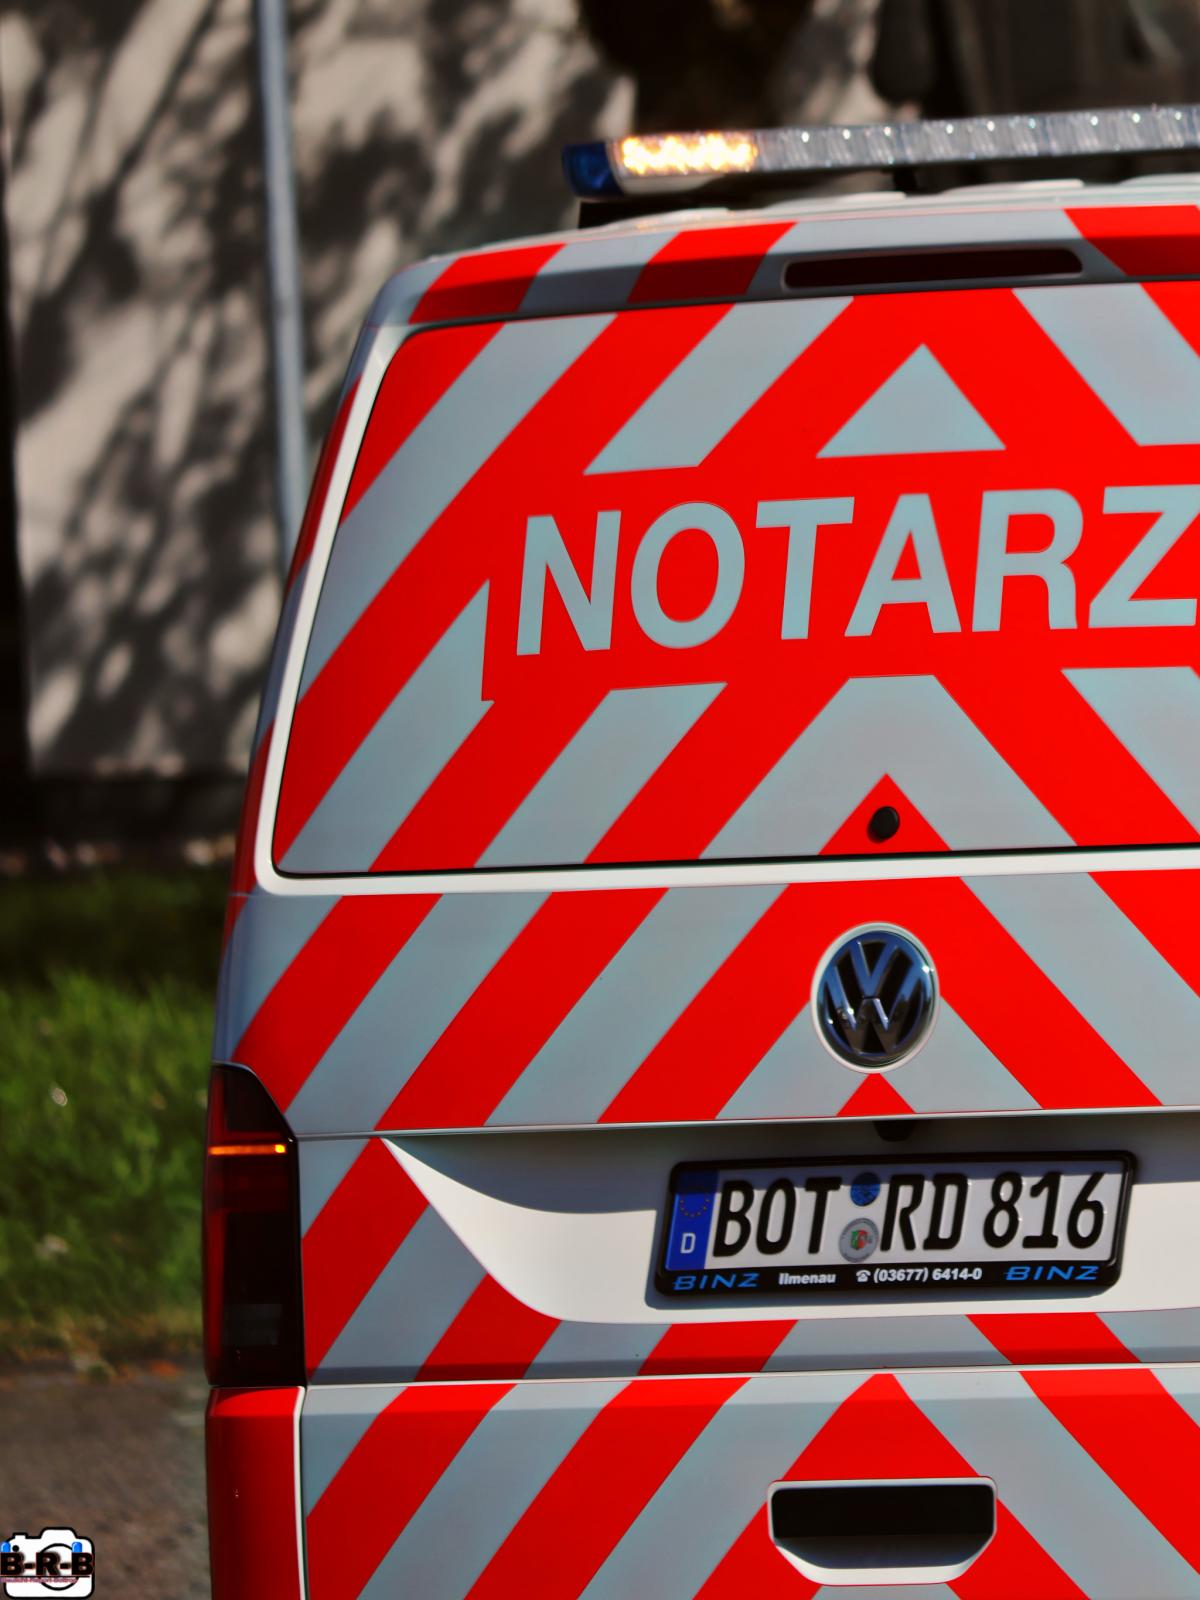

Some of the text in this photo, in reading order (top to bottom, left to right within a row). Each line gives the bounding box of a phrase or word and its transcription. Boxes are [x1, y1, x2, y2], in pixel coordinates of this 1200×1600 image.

[712, 1176, 842, 1257] BOT
[879, 1172, 970, 1252] RD
[983, 1171, 1108, 1249] 816
[680, 1232, 696, 1254] D
[673, 1272, 760, 1291] BINZ
[873, 1267, 929, 1283] (03677)
[931, 1267, 983, 1281] 6414-0
[1004, 1265, 1100, 1281] BINZ
